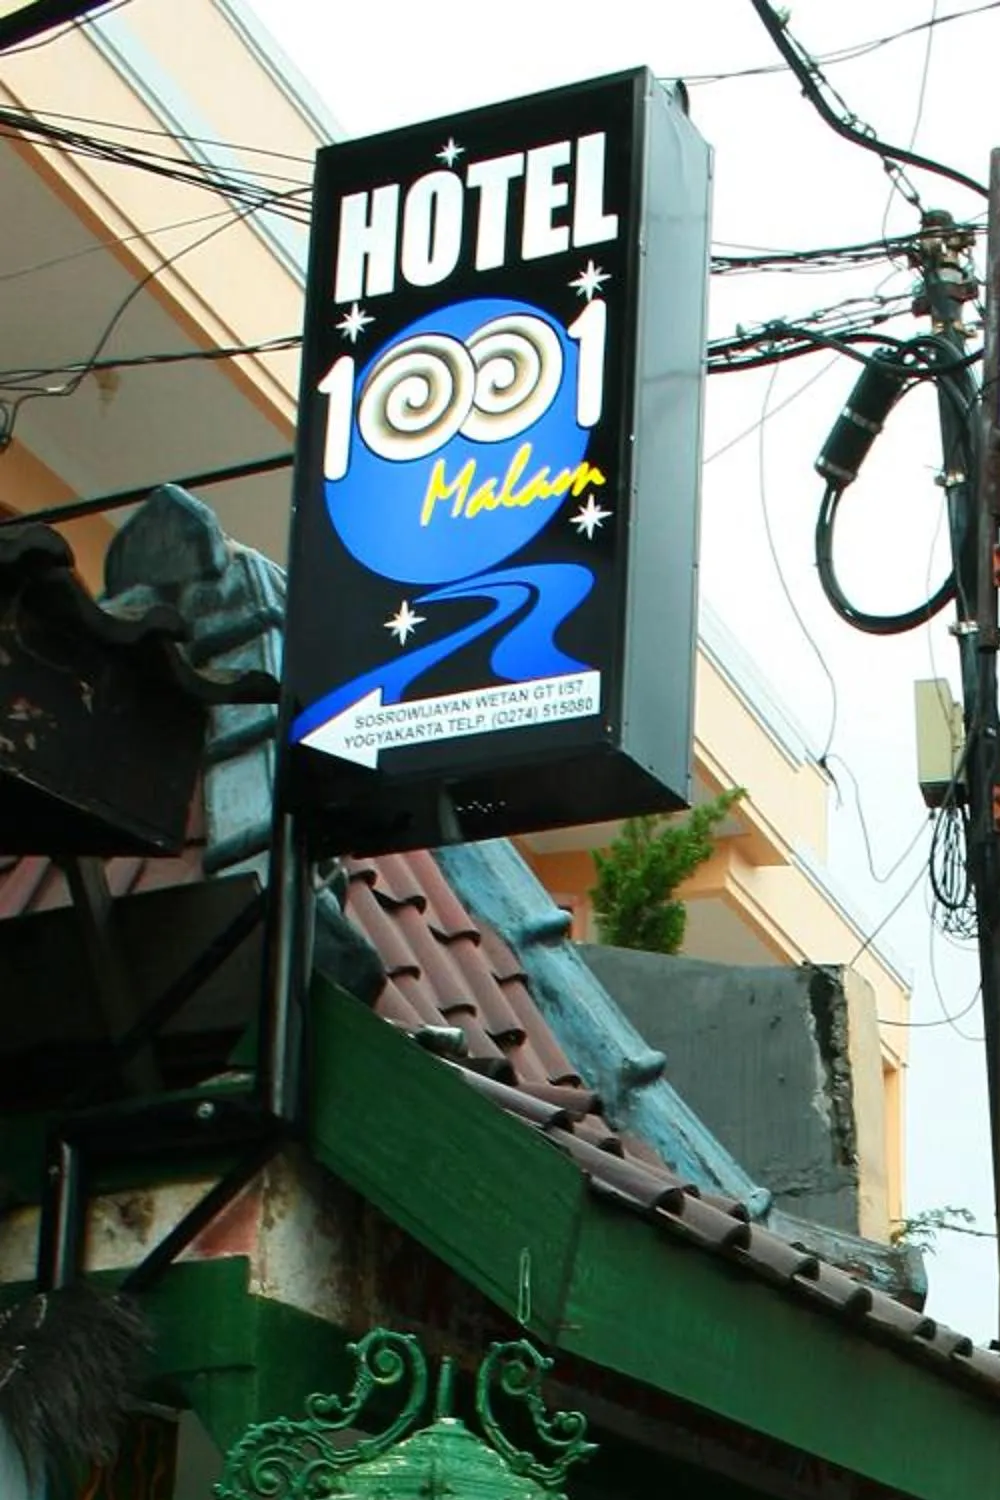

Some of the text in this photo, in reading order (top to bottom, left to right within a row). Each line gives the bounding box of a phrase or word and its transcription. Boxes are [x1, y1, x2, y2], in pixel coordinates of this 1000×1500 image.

[334, 131, 618, 303] HOTEL
[318, 299, 606, 482] 1001
[420, 443, 605, 526] Malam
[343, 718, 444, 749] YOGYAKARTA
[448, 714, 488, 738] TELP.
[475, 688, 530, 715] WETAN
[533, 684, 553, 701] GT
